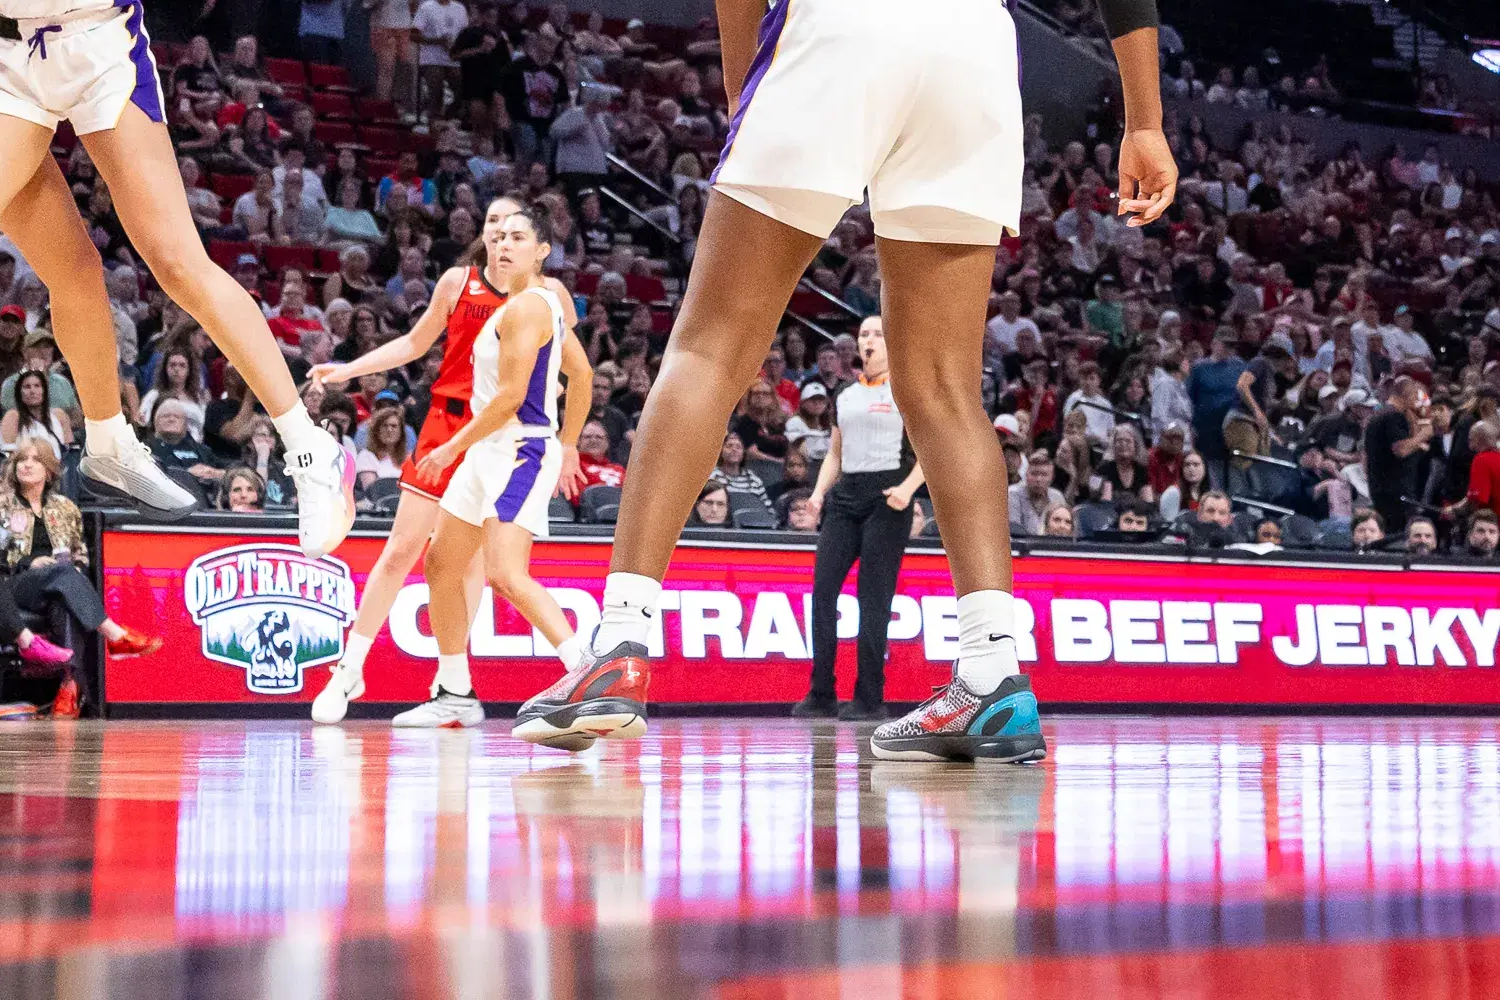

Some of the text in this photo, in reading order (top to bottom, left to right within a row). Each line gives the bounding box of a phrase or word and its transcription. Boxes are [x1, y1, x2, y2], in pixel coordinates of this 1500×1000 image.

[194, 552, 355, 612] OLD TRAPPER
[388, 582, 602, 658] OLD
[1050, 597, 1263, 663] BEEF
[1272, 603, 1500, 667] JERKY
